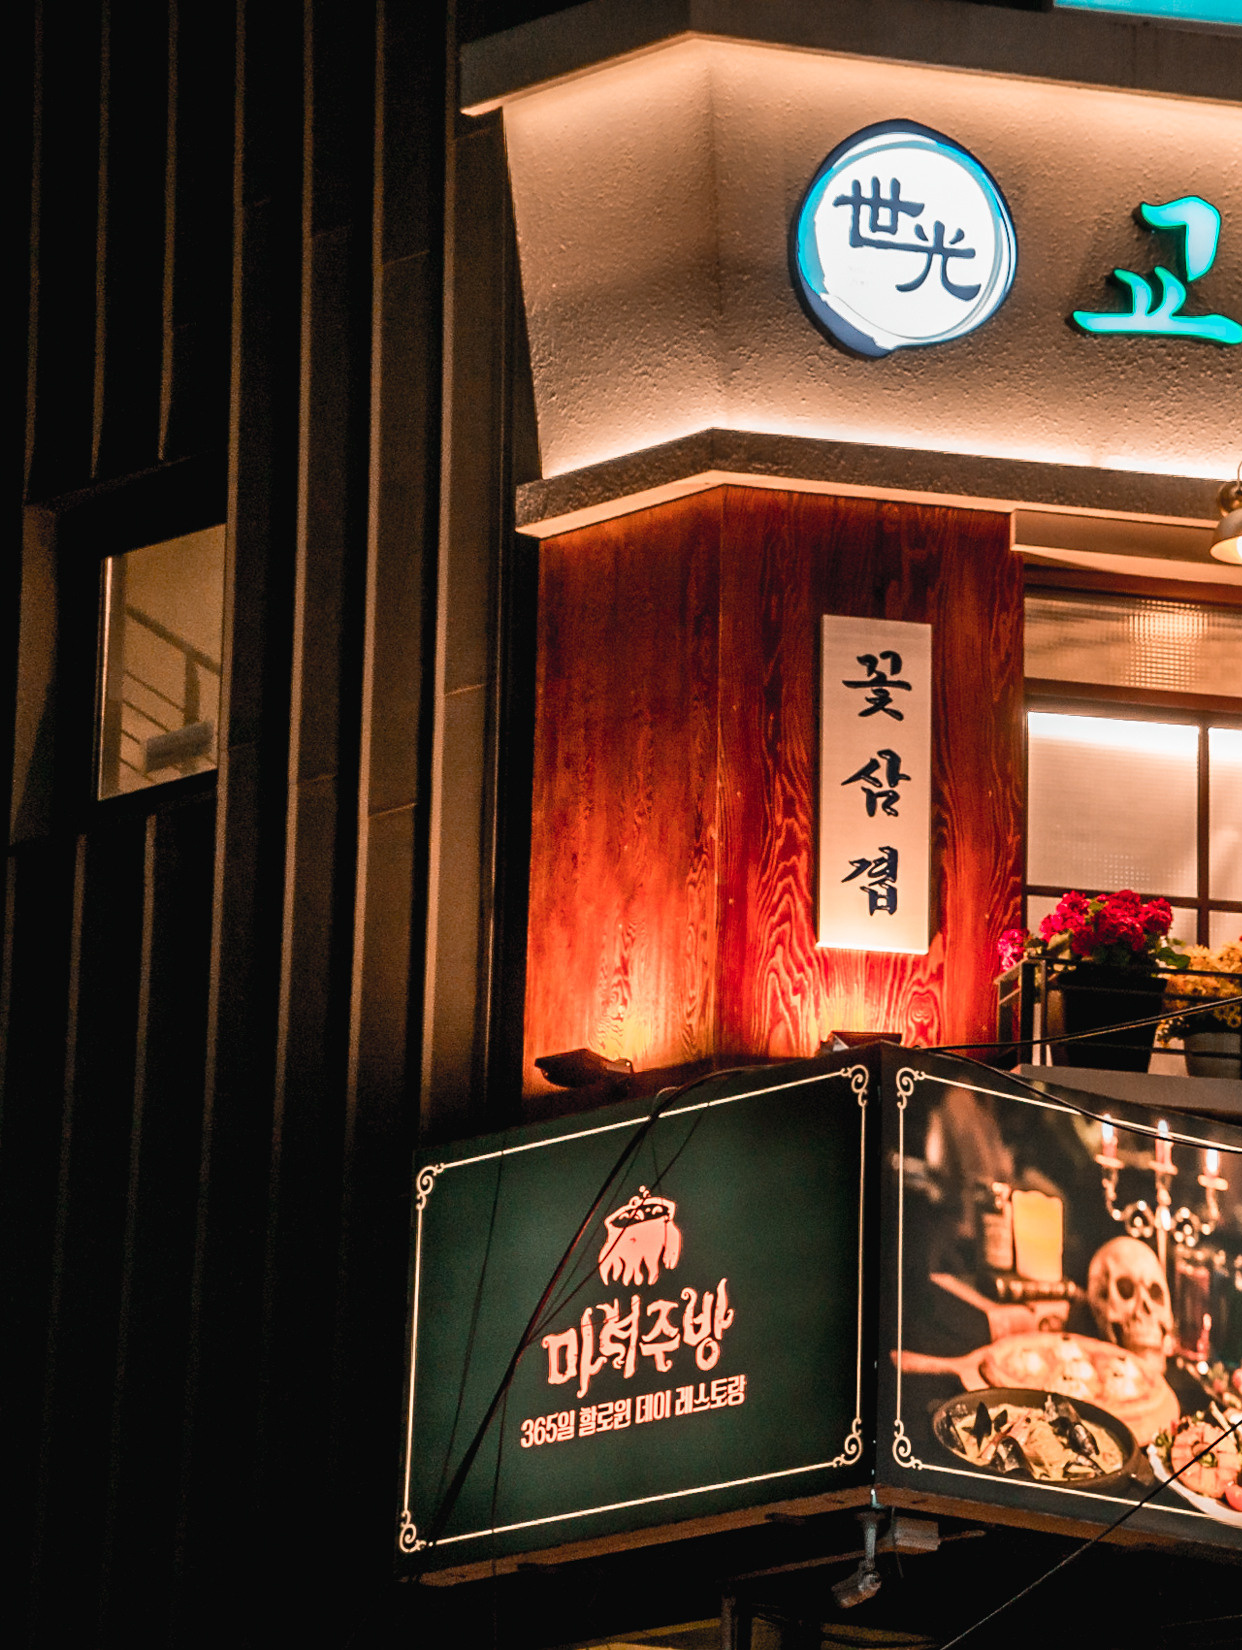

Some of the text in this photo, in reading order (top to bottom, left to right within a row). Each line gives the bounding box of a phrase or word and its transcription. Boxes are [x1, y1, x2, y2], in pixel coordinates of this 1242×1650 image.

[833, 176, 981, 301] 世光
[841, 650, 912, 916] 꽃삼겹
[541, 1277, 735, 1399] 마녀주방
[520, 1374, 748, 1448] 365일 할로윈 데이 레스토랑
